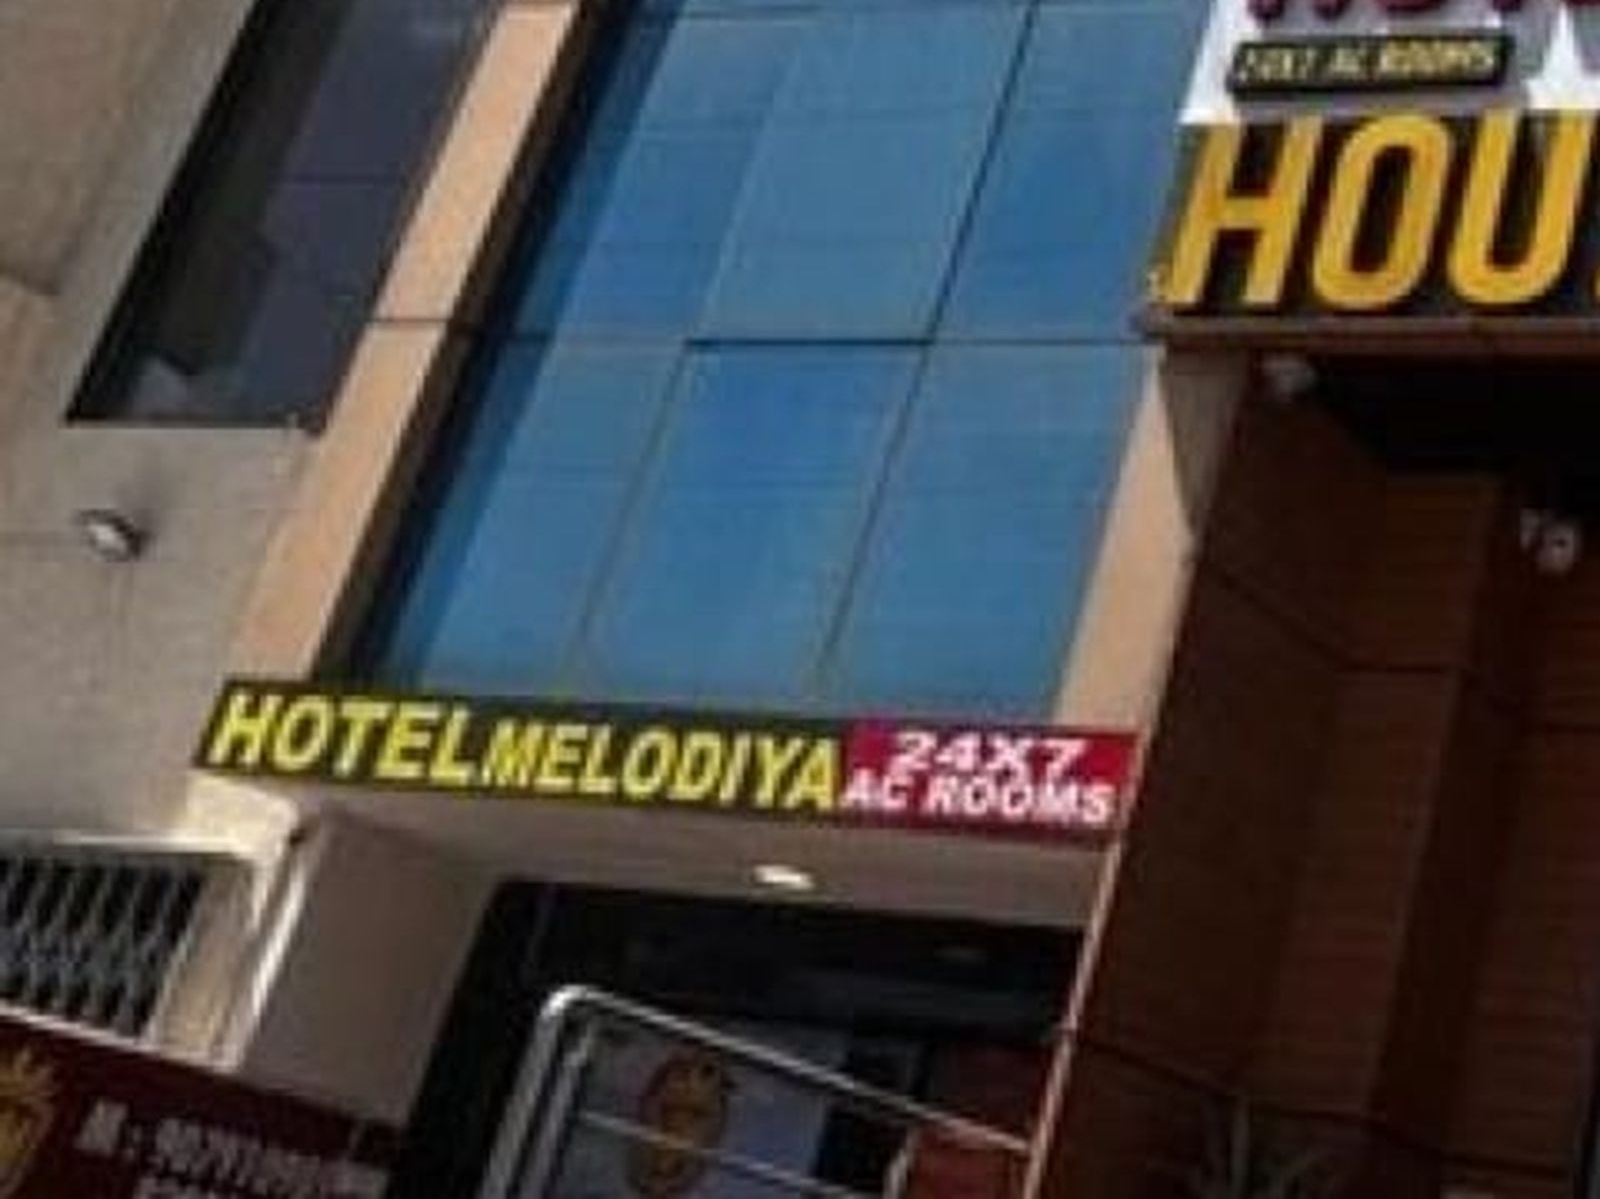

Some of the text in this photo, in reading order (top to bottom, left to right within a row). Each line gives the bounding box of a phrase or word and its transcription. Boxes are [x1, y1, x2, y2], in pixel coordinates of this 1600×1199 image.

[205, 690, 840, 810] HOTEL MELODIYA
[888, 731, 1087, 780] 24X7
[838, 767, 1114, 824] AC ROOMS
